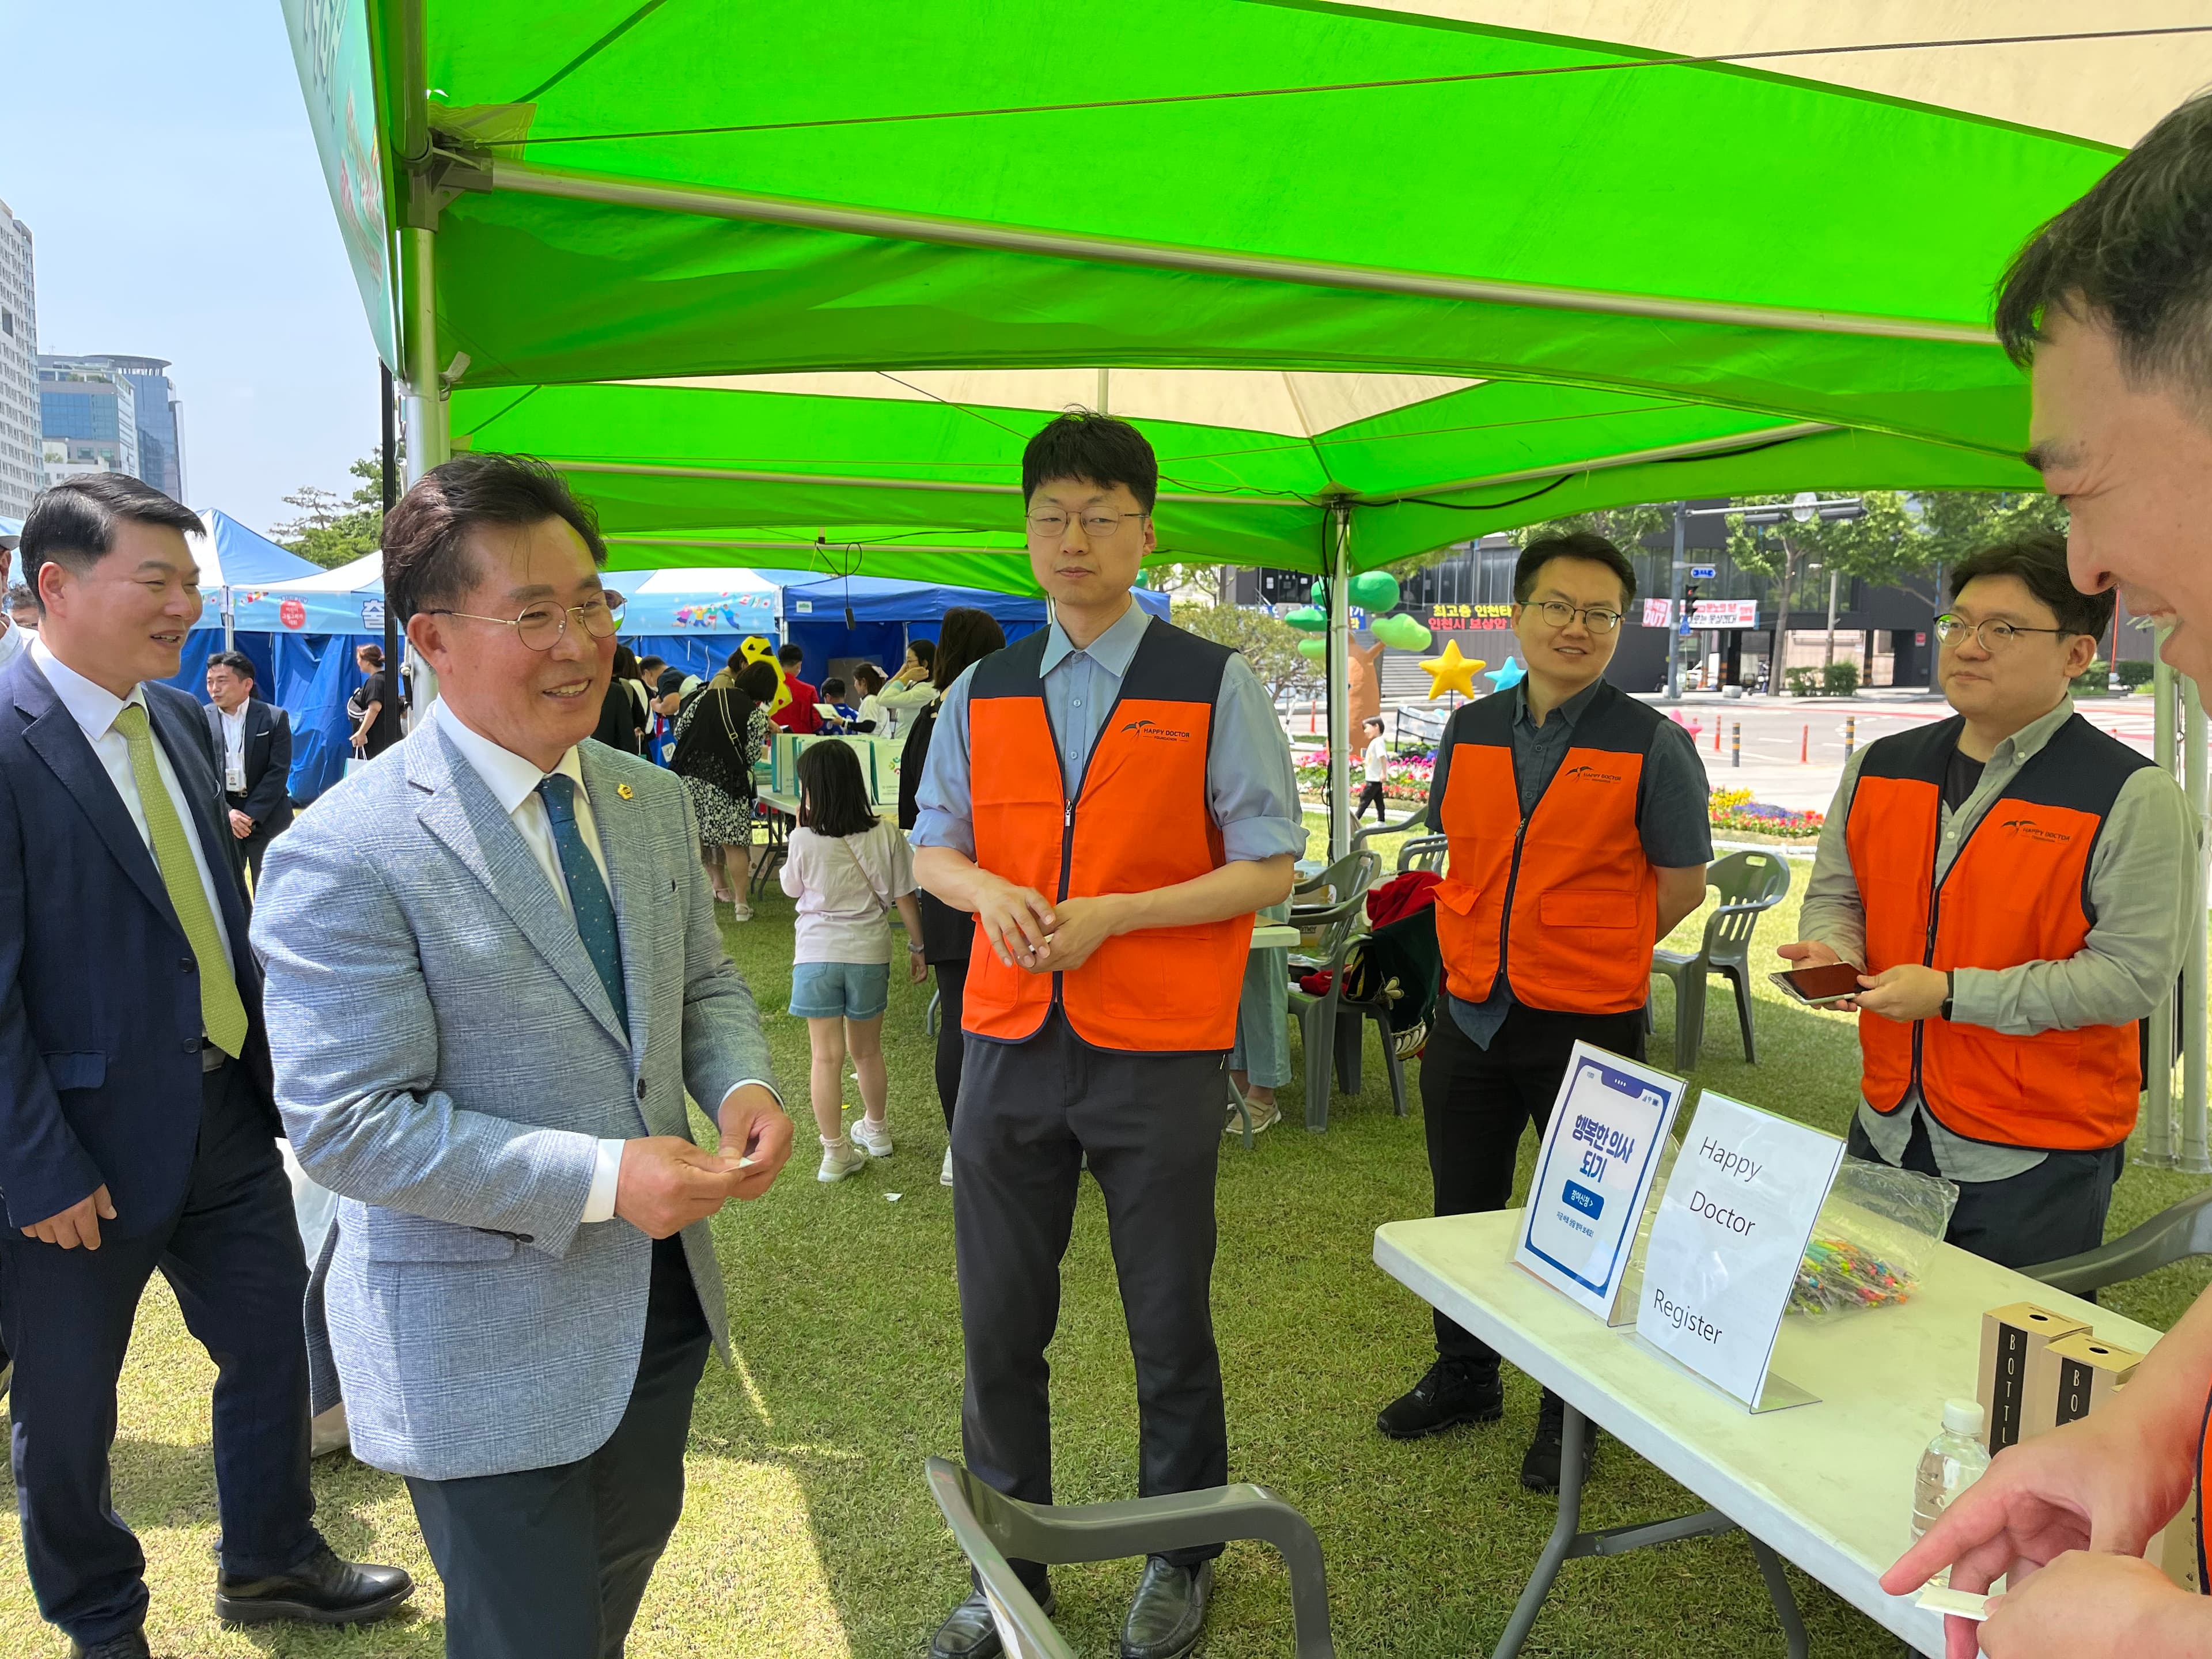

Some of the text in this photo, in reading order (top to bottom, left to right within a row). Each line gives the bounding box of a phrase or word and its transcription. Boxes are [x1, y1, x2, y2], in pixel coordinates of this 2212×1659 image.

[1428, 618, 1465, 630] 인천시
[1469, 618, 1508, 630] 보상안
[1433, 604, 1512, 618] 최고층 인천타
[1643, 609, 1665, 627] OUT
[2045, 832, 2070, 840] DOCTOR
[1572, 1114, 1635, 1164] 행복한 의사
[1580, 1150, 1607, 1183] 되기
[1699, 1136, 1763, 1182] Happy
[1571, 1190, 1590, 1207] 참여신청
[1689, 1190, 1756, 1236] Doctor
[1556, 1211, 1563, 1220] 지금
[1563, 1215, 1569, 1223] 바로
[1654, 1288, 1722, 1344] Register
[2002, 1334, 2016, 1444] BOTTL
[2069, 1369, 2080, 1422] BO
